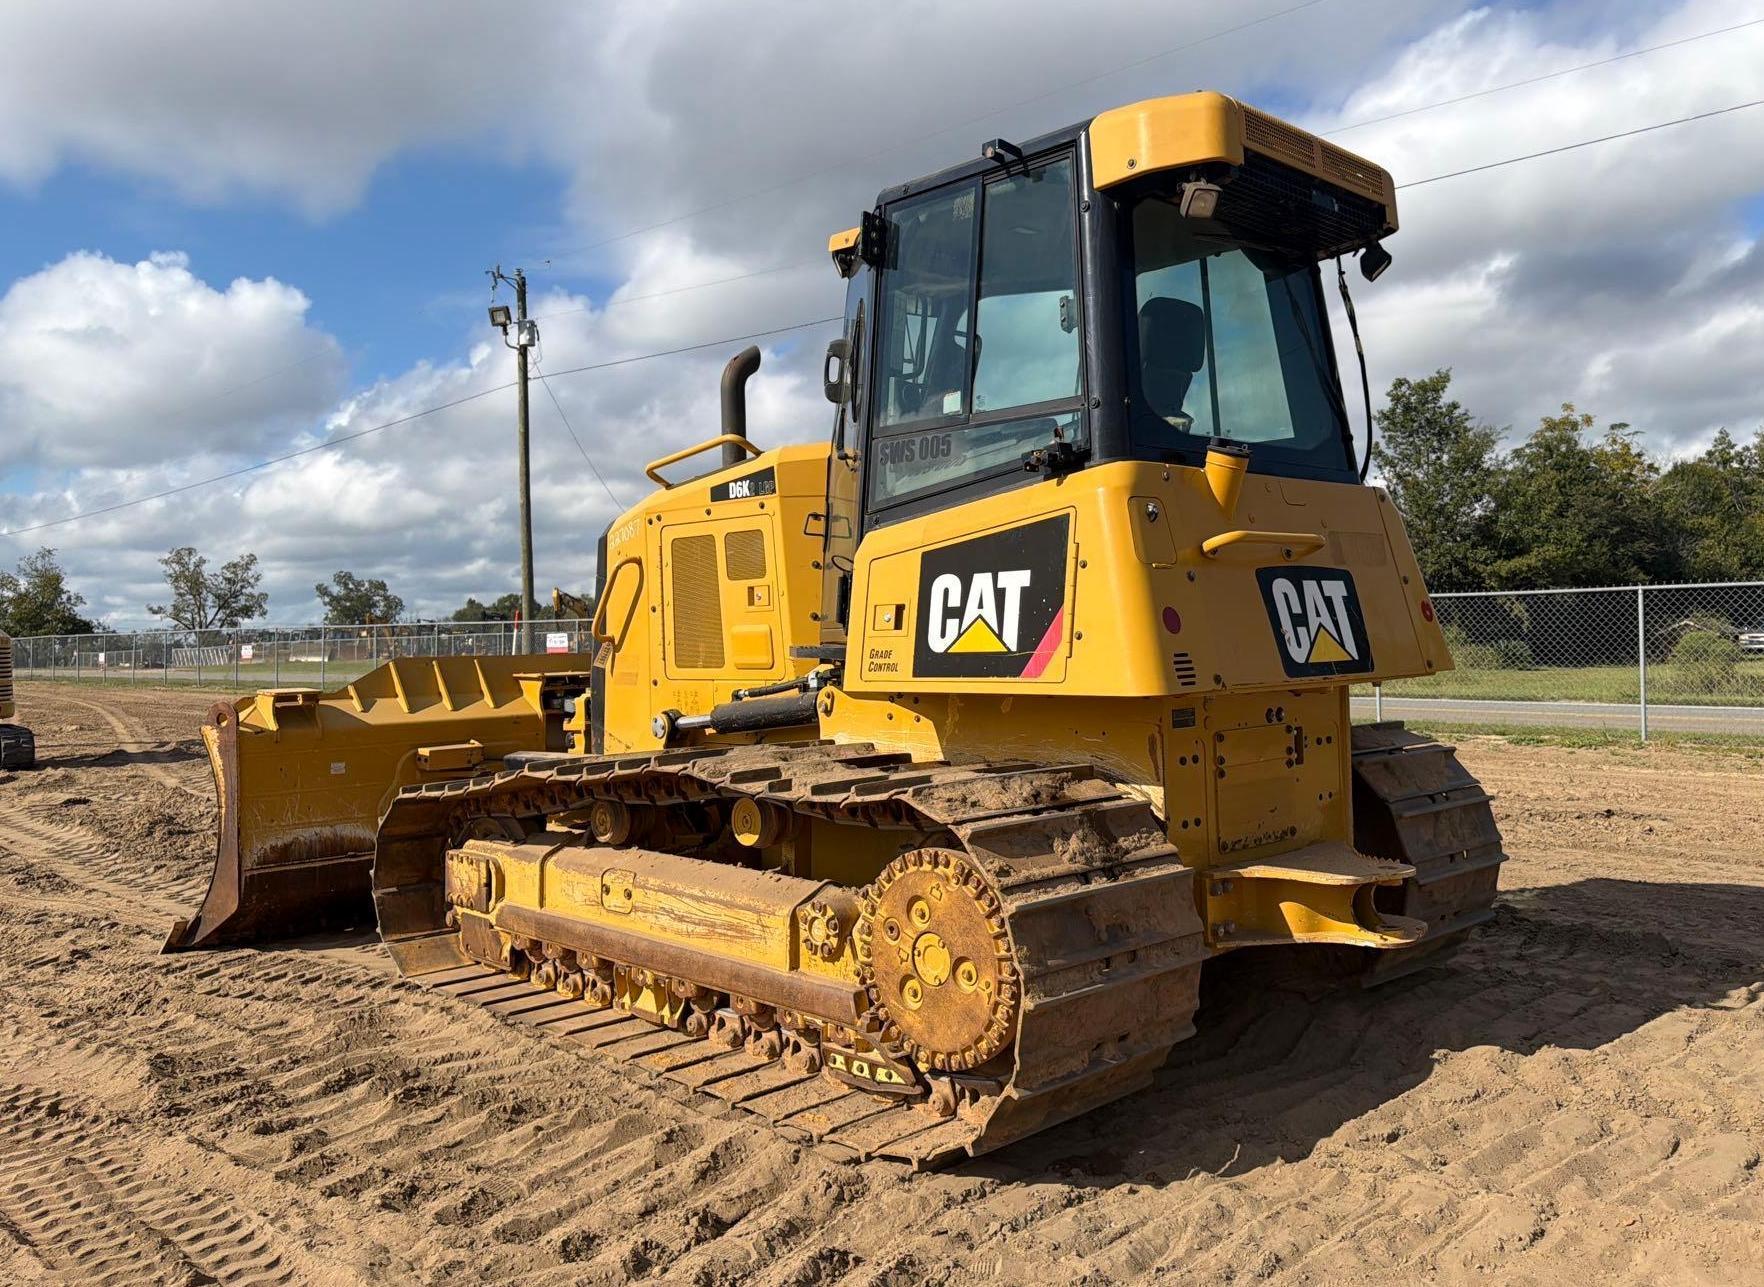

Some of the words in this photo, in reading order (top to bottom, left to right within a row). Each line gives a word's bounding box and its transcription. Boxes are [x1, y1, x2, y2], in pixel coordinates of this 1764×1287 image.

[919, 433, 952, 460] 005
[928, 569, 1031, 653] CAT
[1272, 577, 1359, 664] CAT
[868, 661, 898, 672] CONTROL
[869, 648, 893, 659] GRADE
